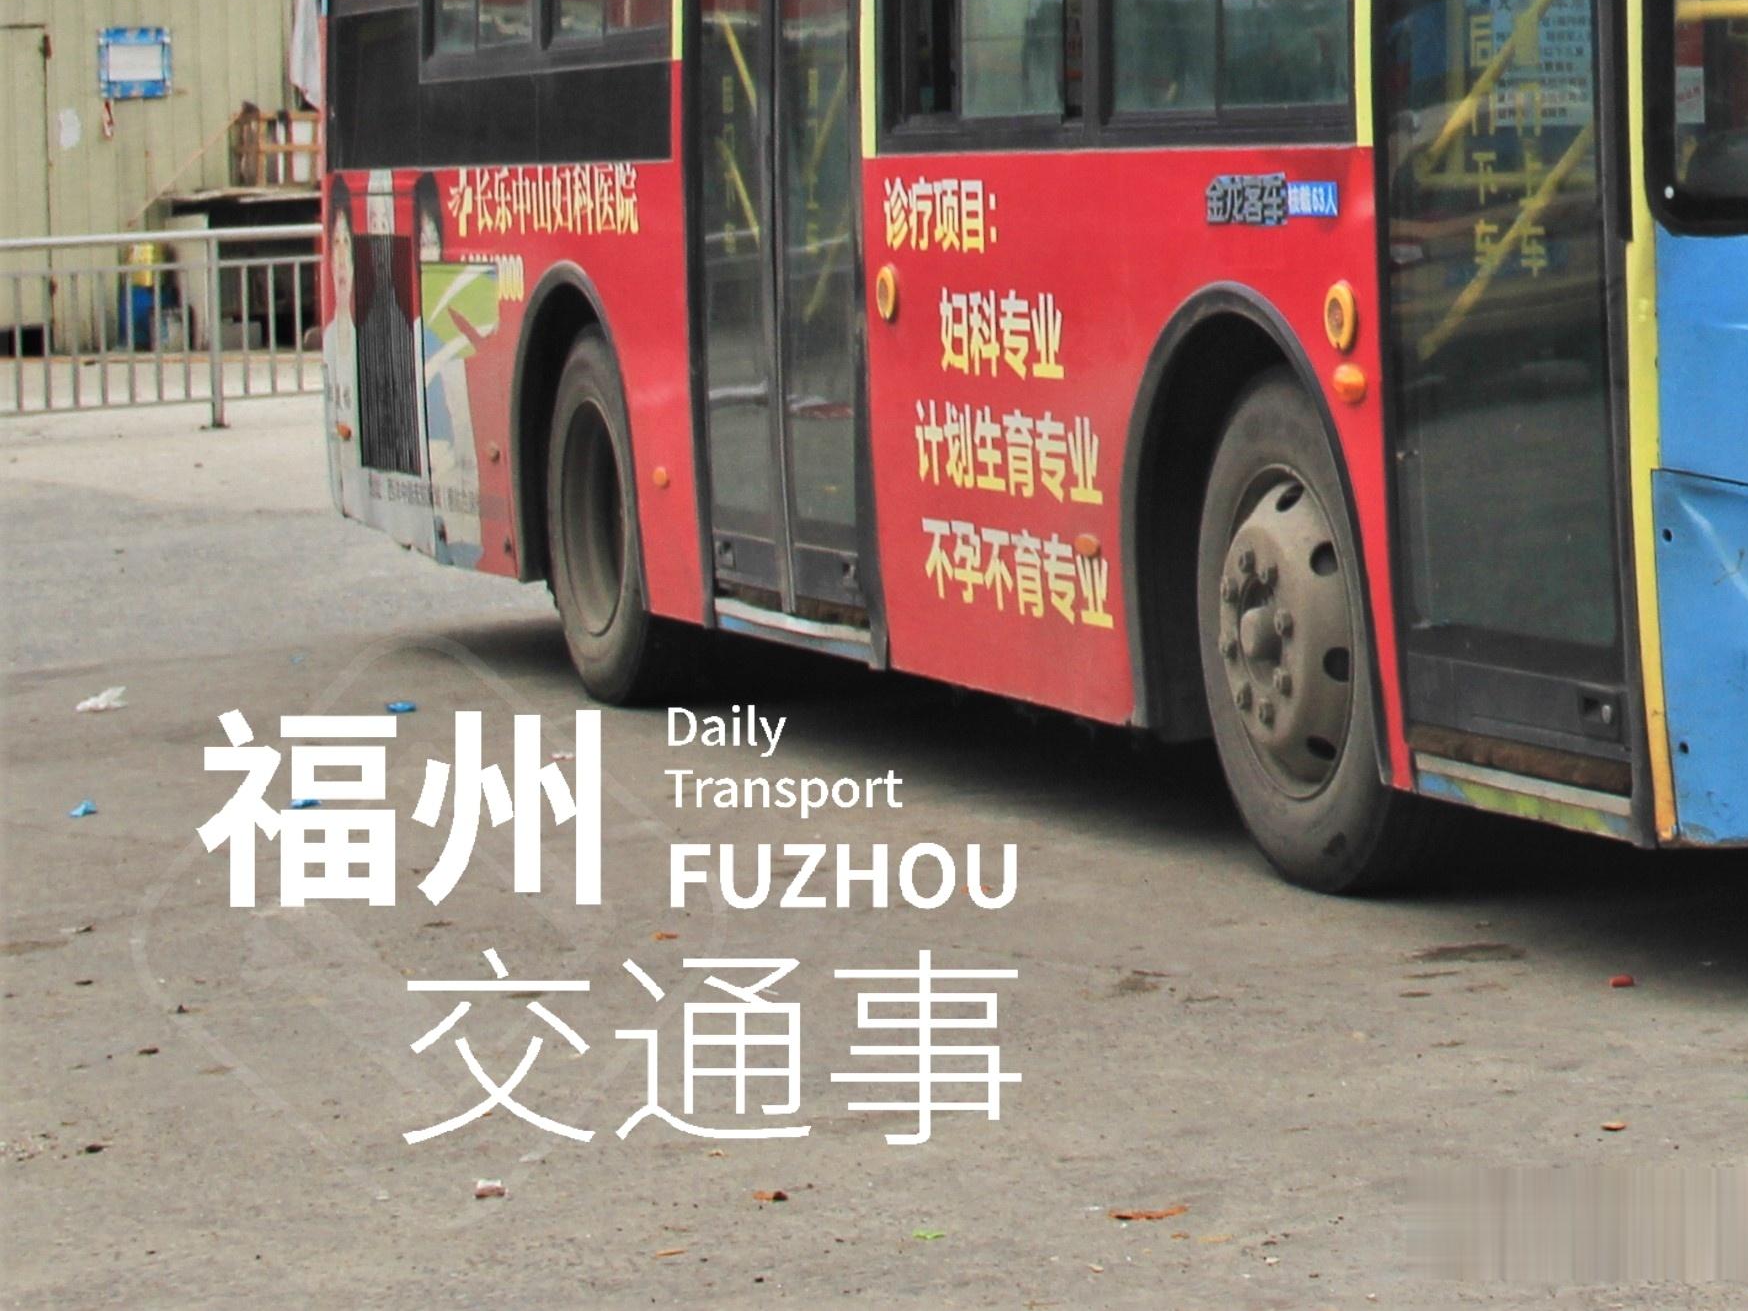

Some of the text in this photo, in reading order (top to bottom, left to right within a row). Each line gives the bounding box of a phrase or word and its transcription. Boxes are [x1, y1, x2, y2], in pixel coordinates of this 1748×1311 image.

[940, 286, 1065, 380] 妇科专业
[915, 399, 1103, 505] 计划生育专业
[922, 517, 1115, 630] 不孕不育专业
